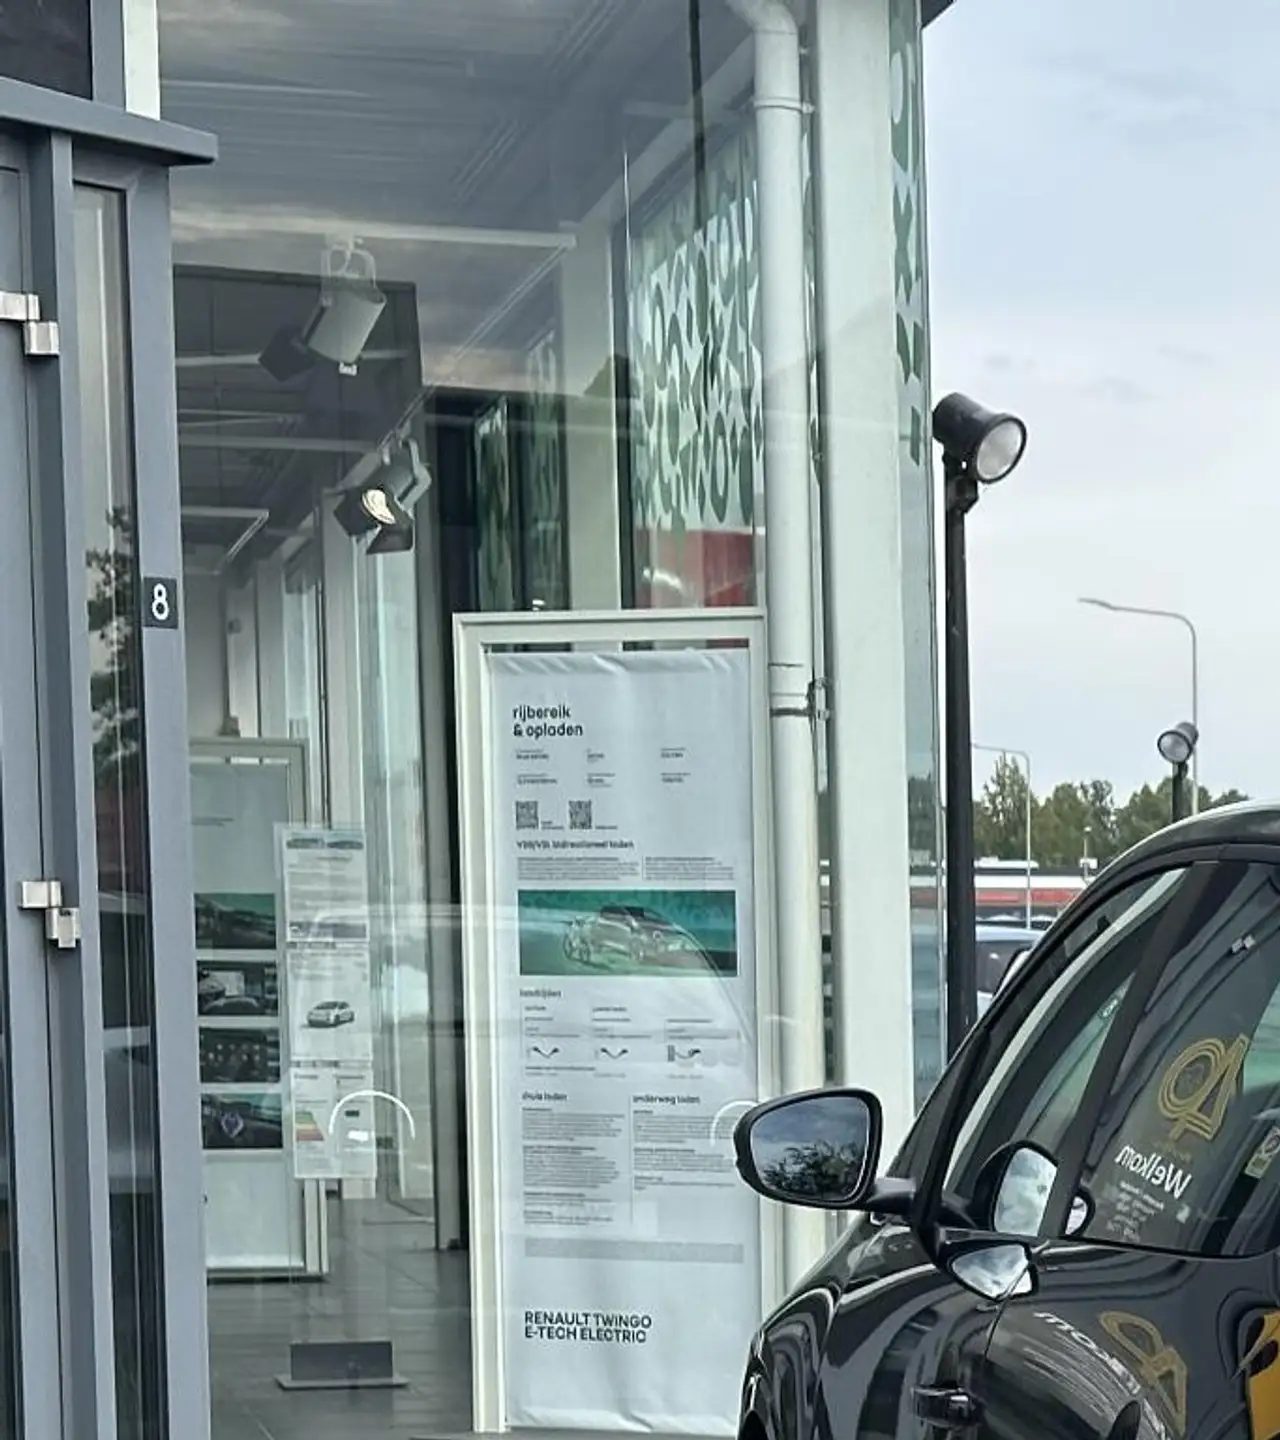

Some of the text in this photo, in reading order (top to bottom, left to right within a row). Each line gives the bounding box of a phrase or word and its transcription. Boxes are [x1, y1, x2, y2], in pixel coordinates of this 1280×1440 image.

[152, 582, 169, 621] 8
[512, 704, 572, 722] rijbereik
[513, 722, 583, 740] & opladen
[525, 1310, 652, 1328] RENAULT TWINGO
[524, 1325, 646, 1344] E-TECH ELECTRIC
